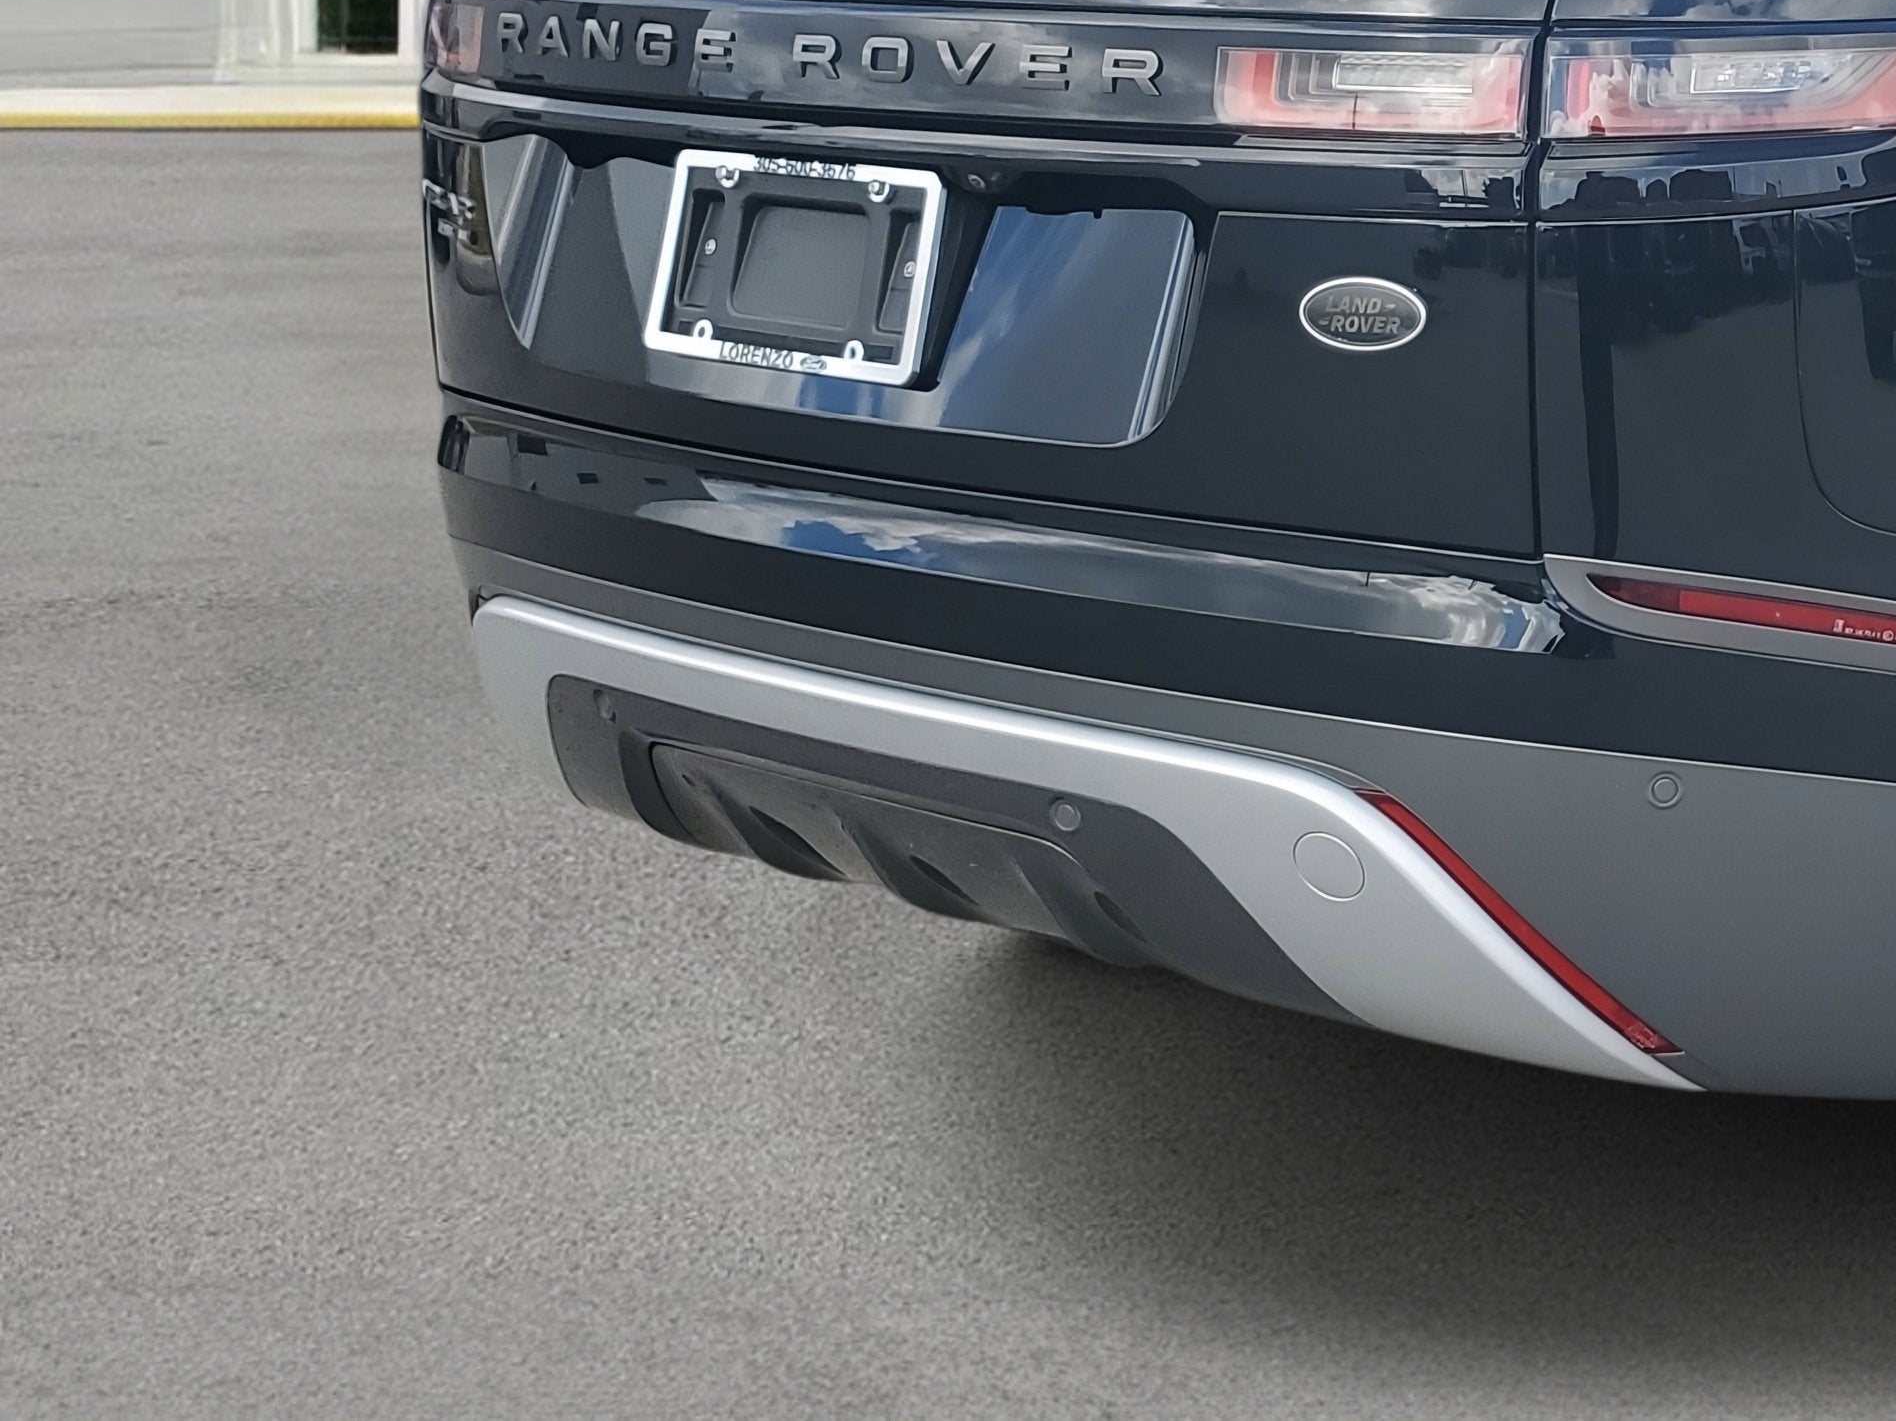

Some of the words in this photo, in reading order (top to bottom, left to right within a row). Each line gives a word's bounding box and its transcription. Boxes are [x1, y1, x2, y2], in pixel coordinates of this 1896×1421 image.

[496, 12, 738, 73] RANGE
[791, 32, 1164, 97] ROVER
[1325, 296, 1382, 314] LAND
[1331, 315, 1402, 335] ROVER
[719, 340, 794, 369] LORENZO
